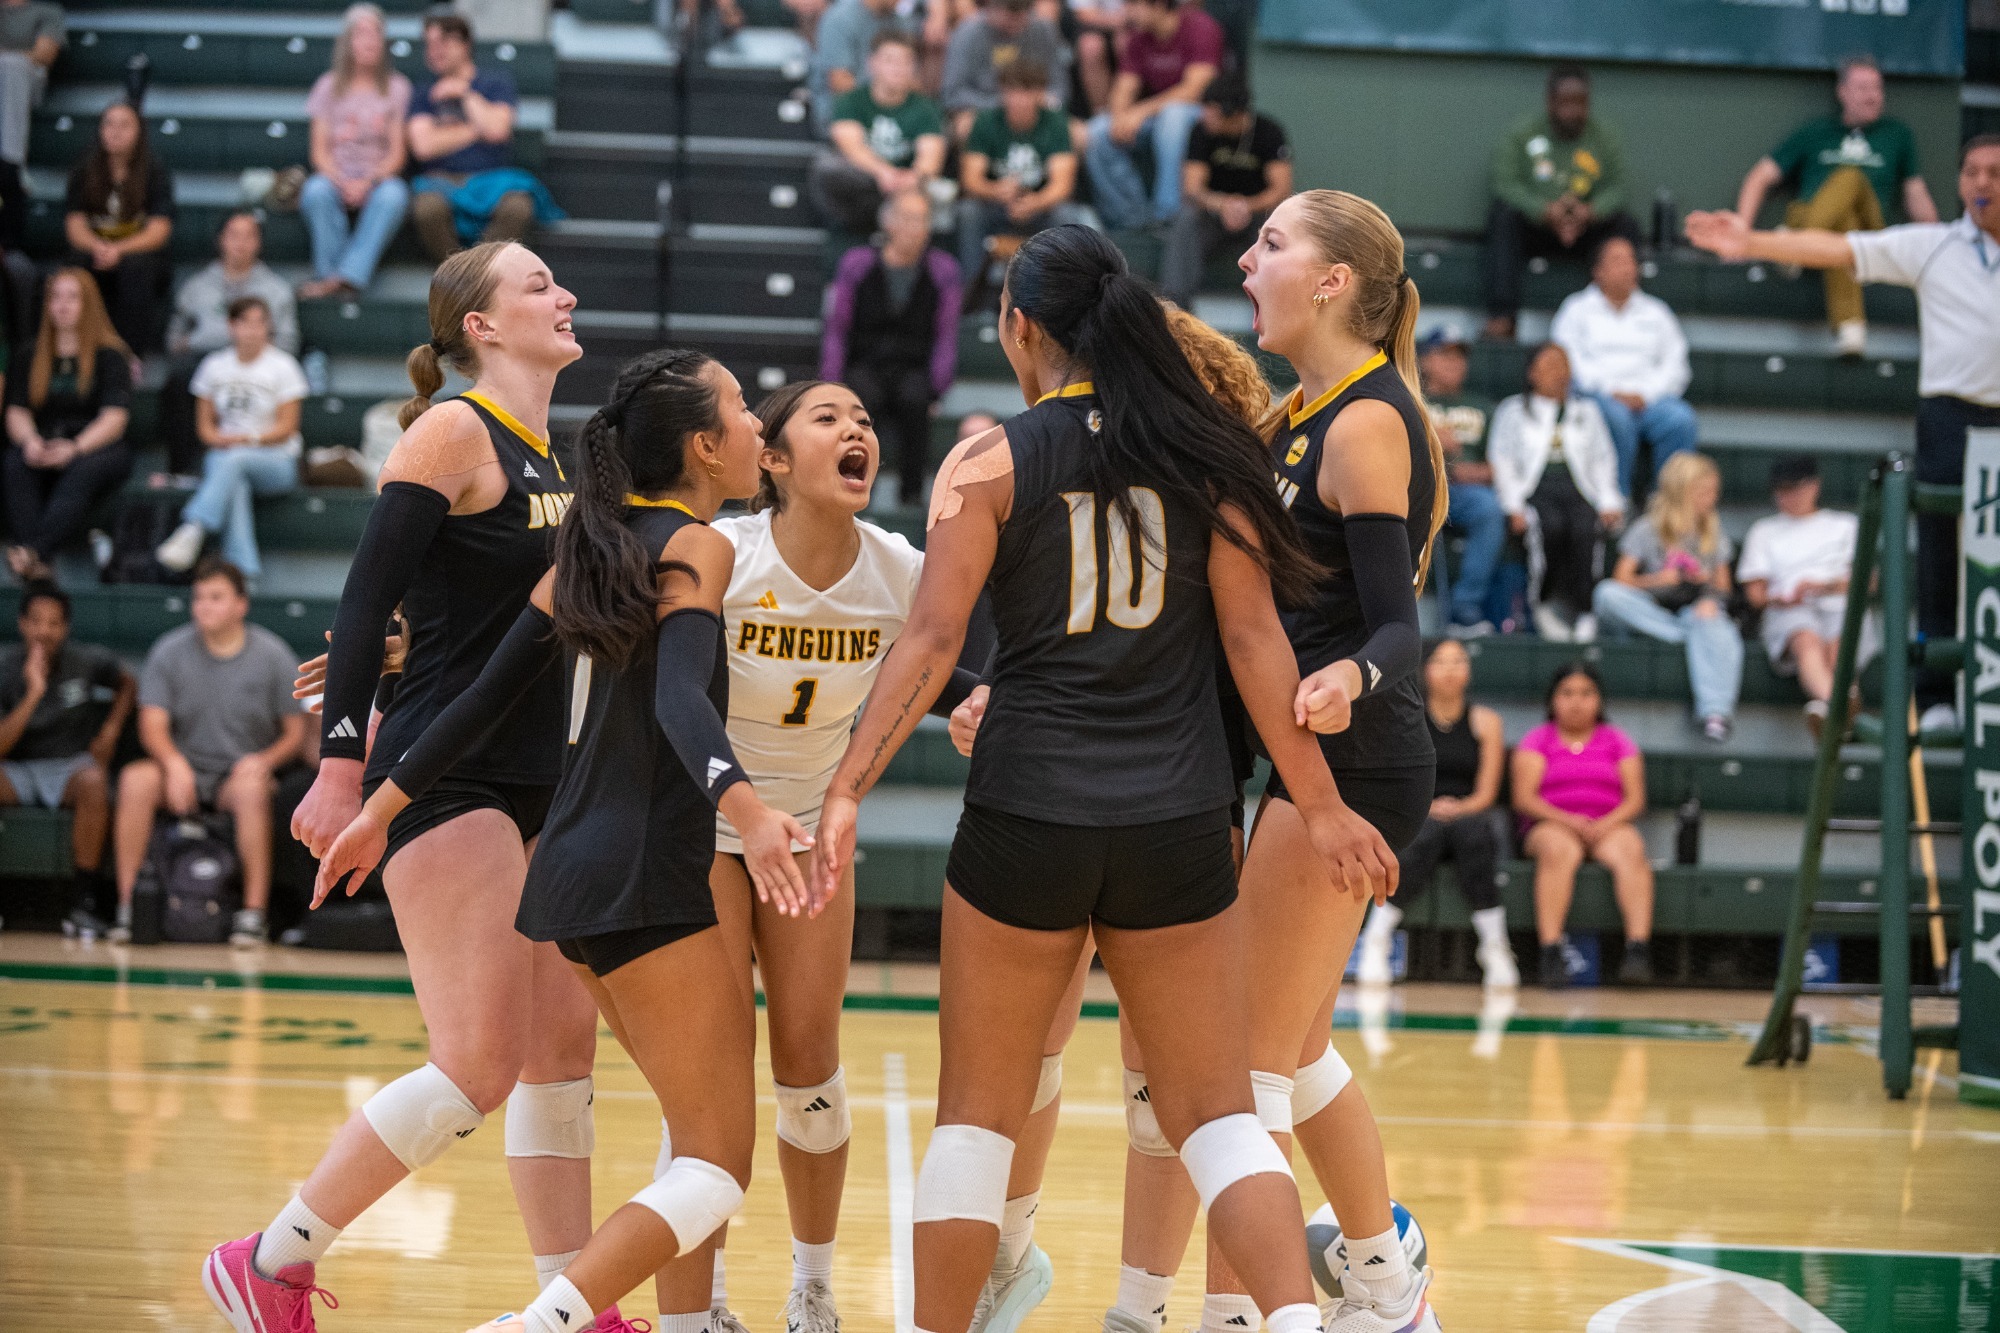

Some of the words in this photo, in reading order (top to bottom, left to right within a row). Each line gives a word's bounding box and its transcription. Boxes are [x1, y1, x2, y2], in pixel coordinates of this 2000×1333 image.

[1058, 486, 1168, 635] 10
[736, 620, 881, 663] PENGUINS
[781, 677, 819, 727] 1
[1973, 586, 2000, 748] CAL
[1972, 768, 2000, 979] POLY
